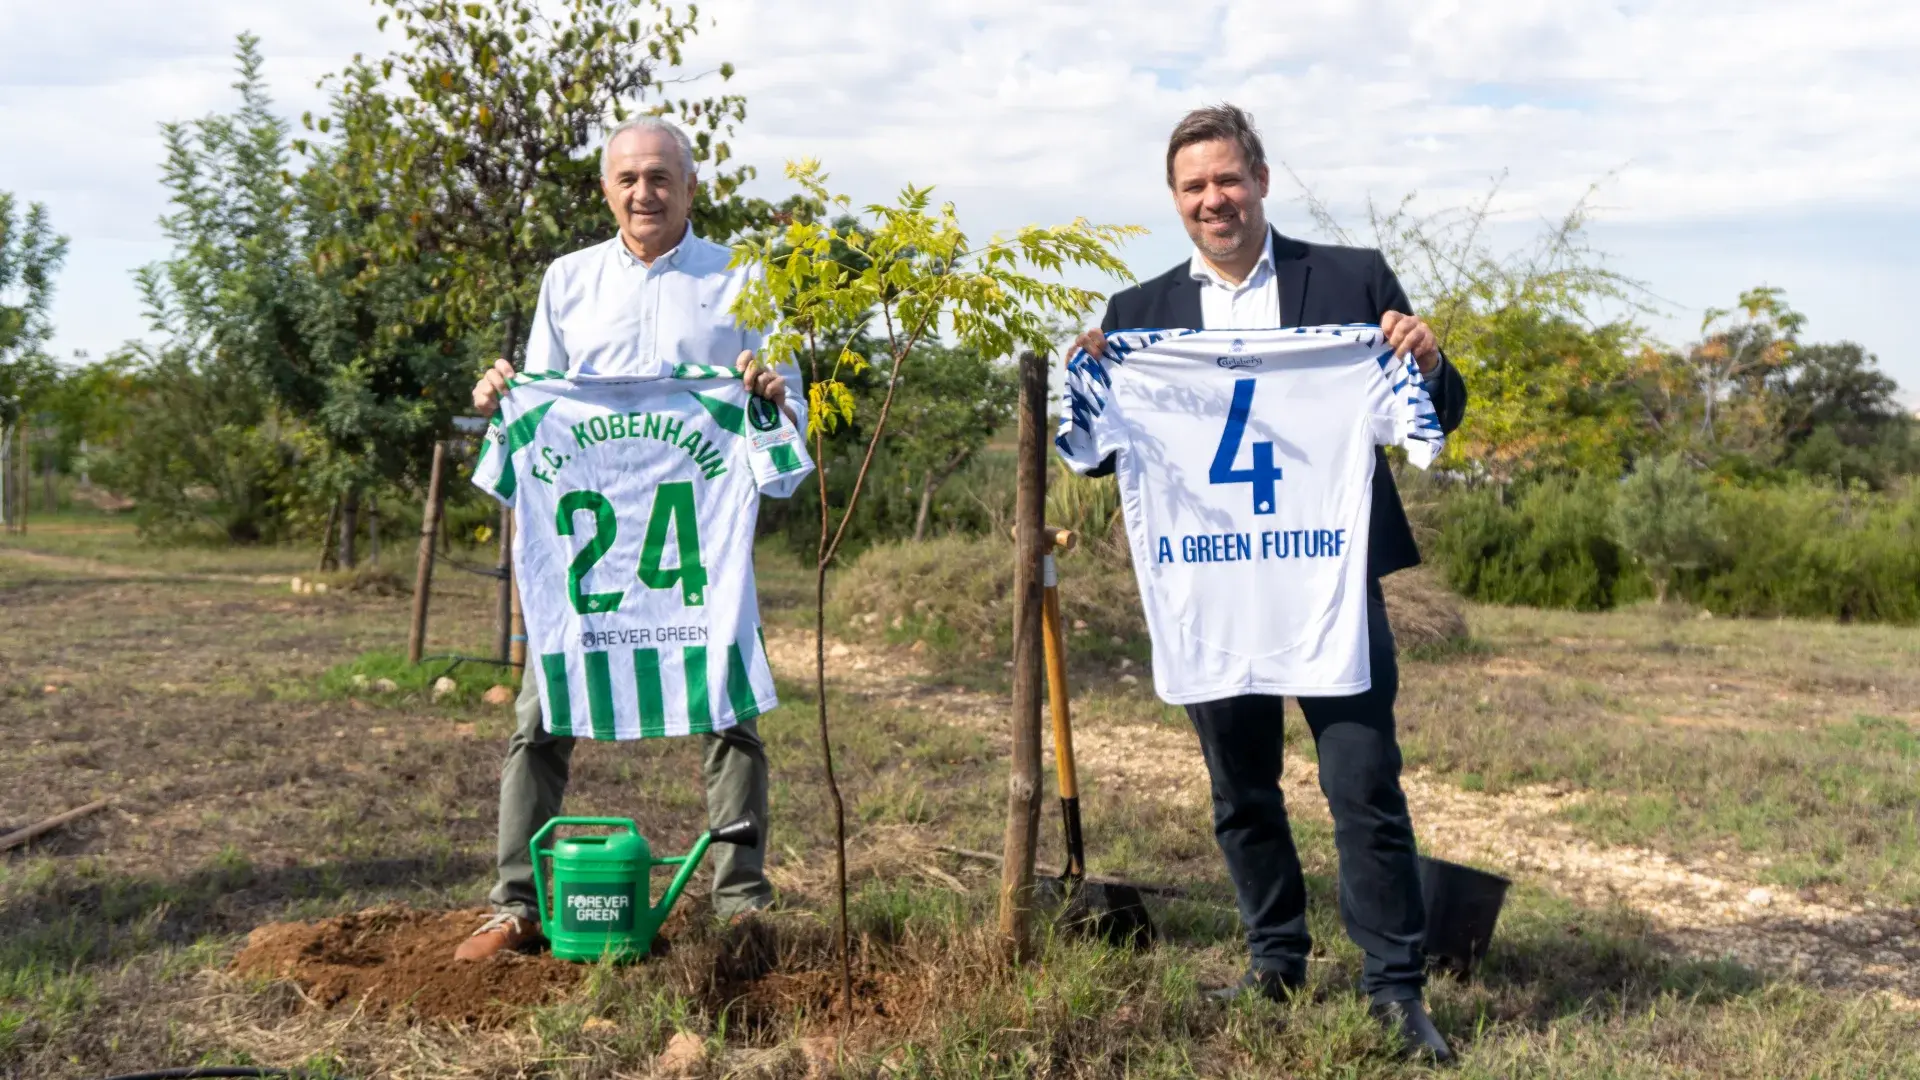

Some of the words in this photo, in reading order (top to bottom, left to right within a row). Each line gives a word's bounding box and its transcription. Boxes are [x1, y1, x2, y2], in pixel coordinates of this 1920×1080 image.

[1216, 356, 1263, 369] Carlsberg
[531, 446, 571, 484] F.C.
[571, 412, 728, 481] KOBENHAVN
[1209, 378, 1283, 515] 4
[556, 480, 708, 615] 24
[1159, 536, 1174, 563] A
[1182, 533, 1251, 563] GREEN
[656, 626, 708, 642] GREEN
[567, 895, 629, 908] FOREVER
[576, 909, 619, 921] GREEN
